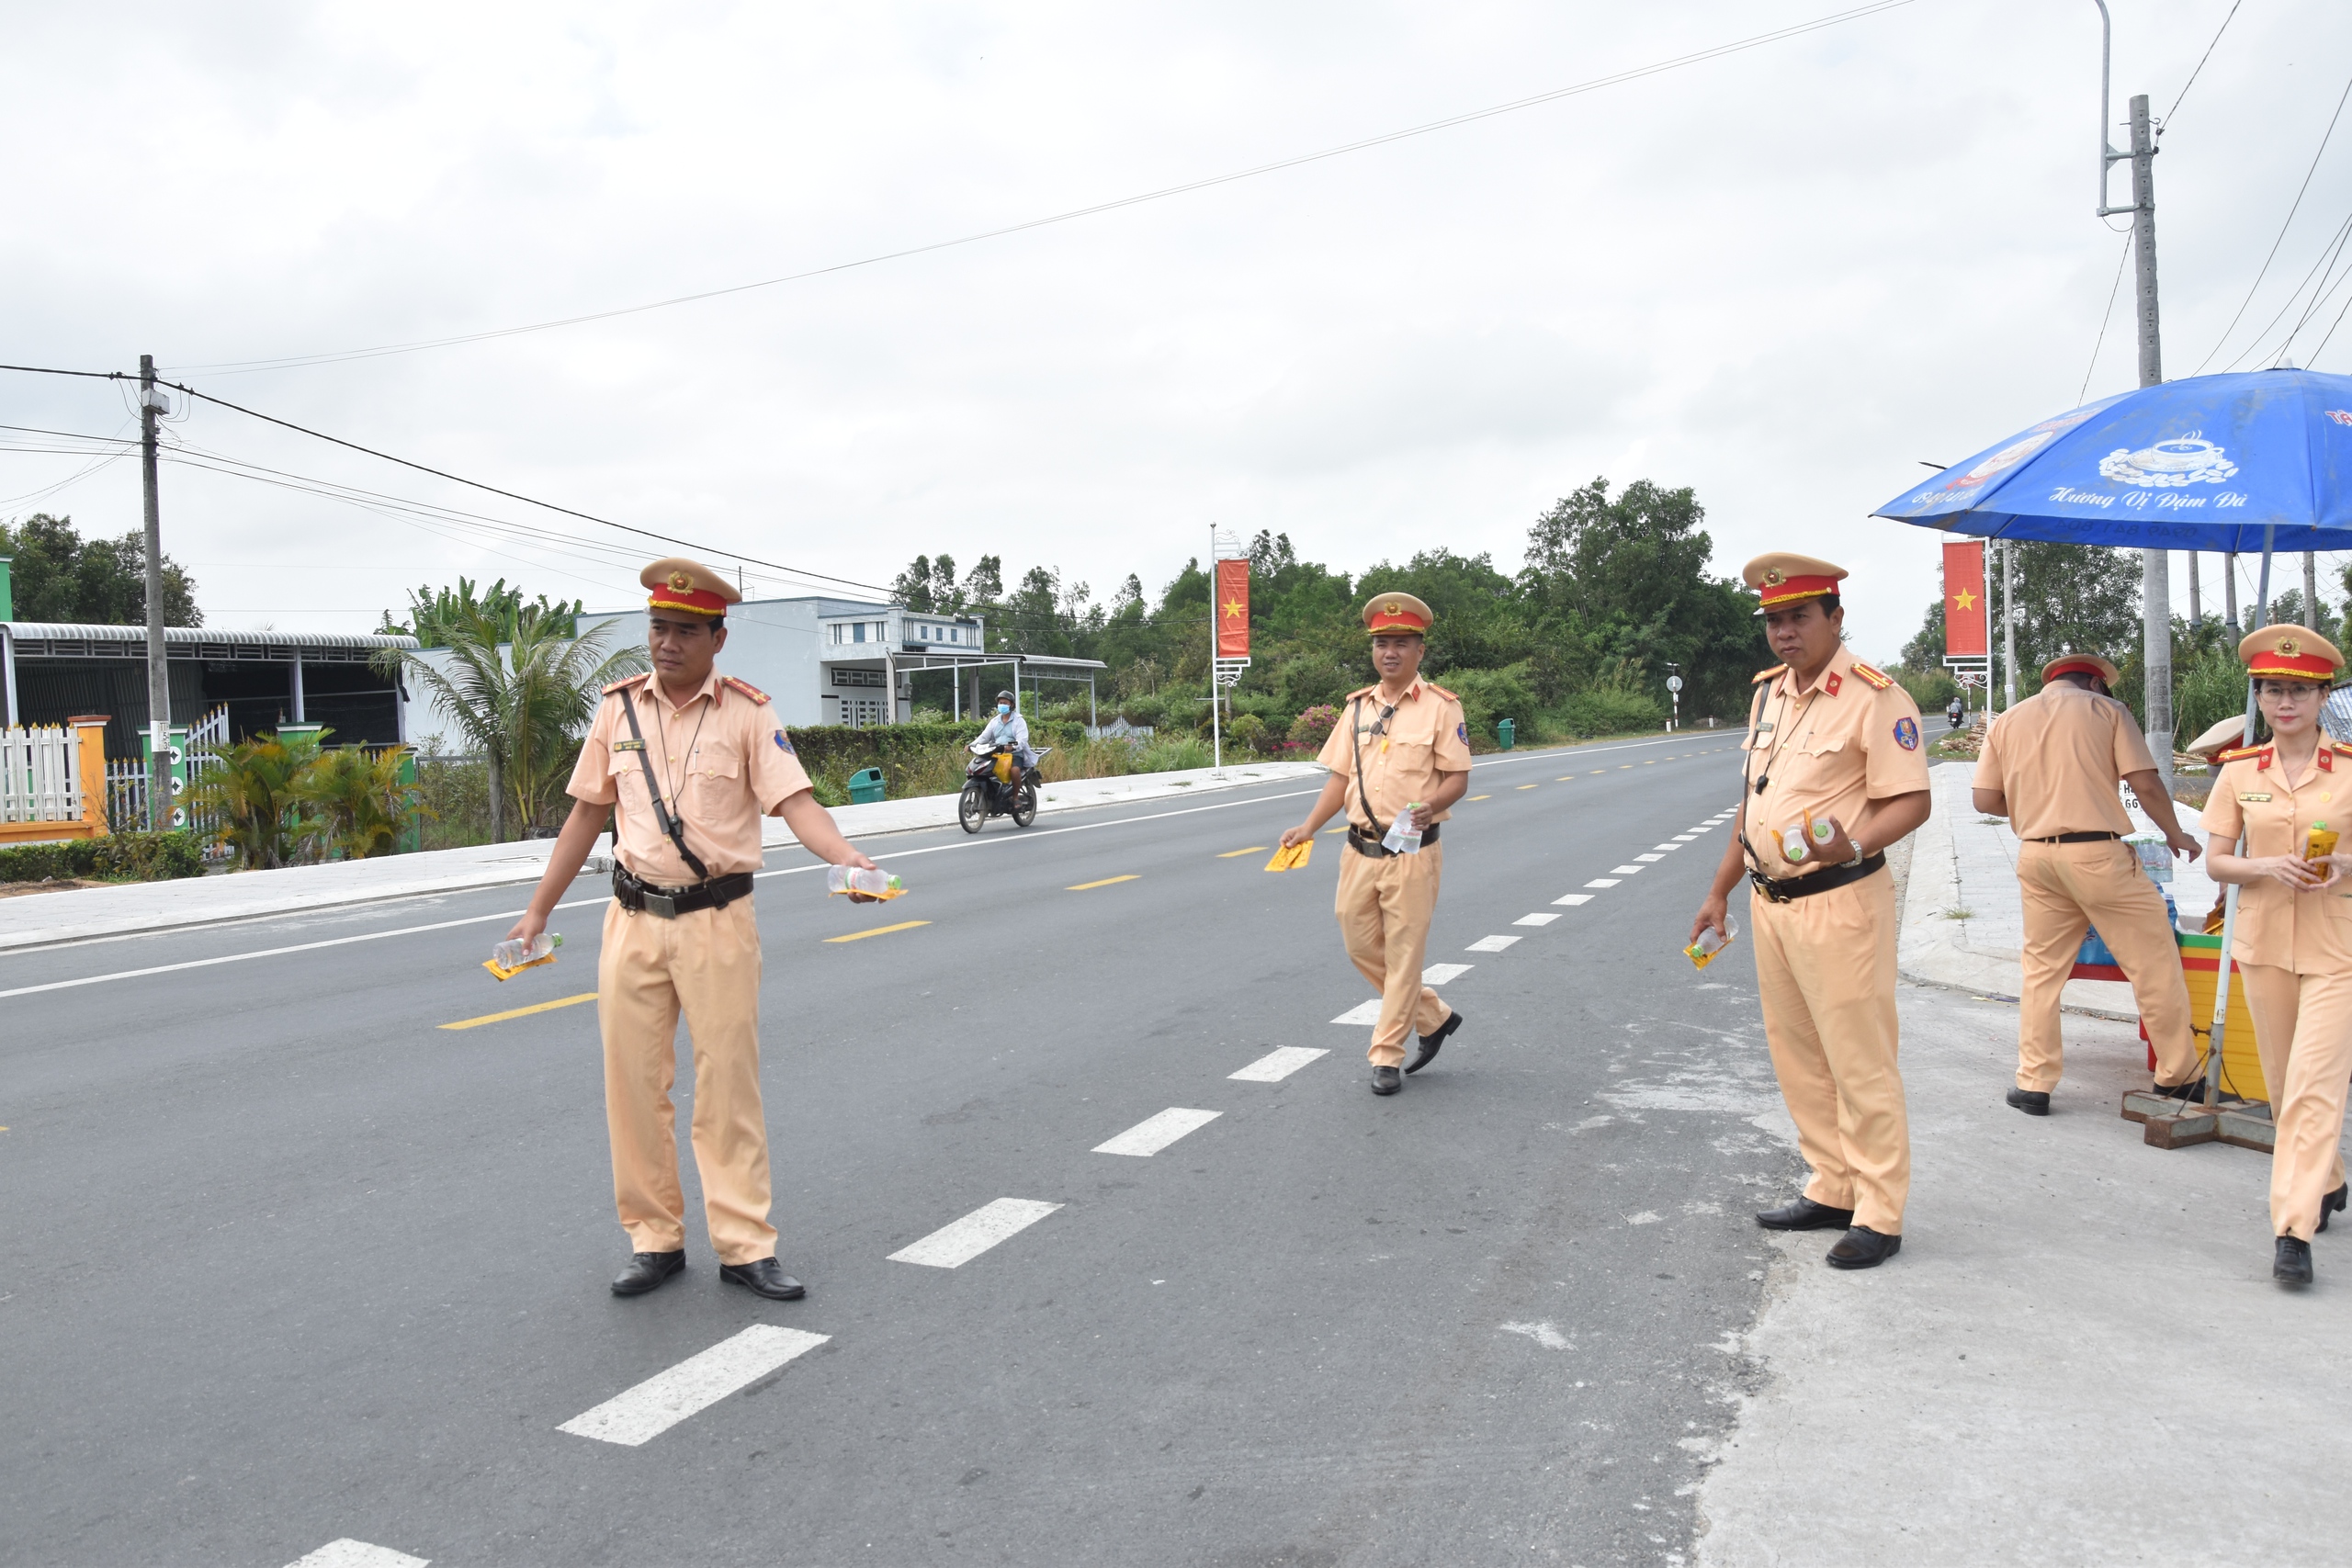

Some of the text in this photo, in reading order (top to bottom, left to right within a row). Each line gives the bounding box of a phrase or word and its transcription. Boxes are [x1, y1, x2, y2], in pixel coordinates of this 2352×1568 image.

[2324, 409, 2352, 426] TÂ
[2048, 487, 2248, 511] Hương Vị Đậm Đà
